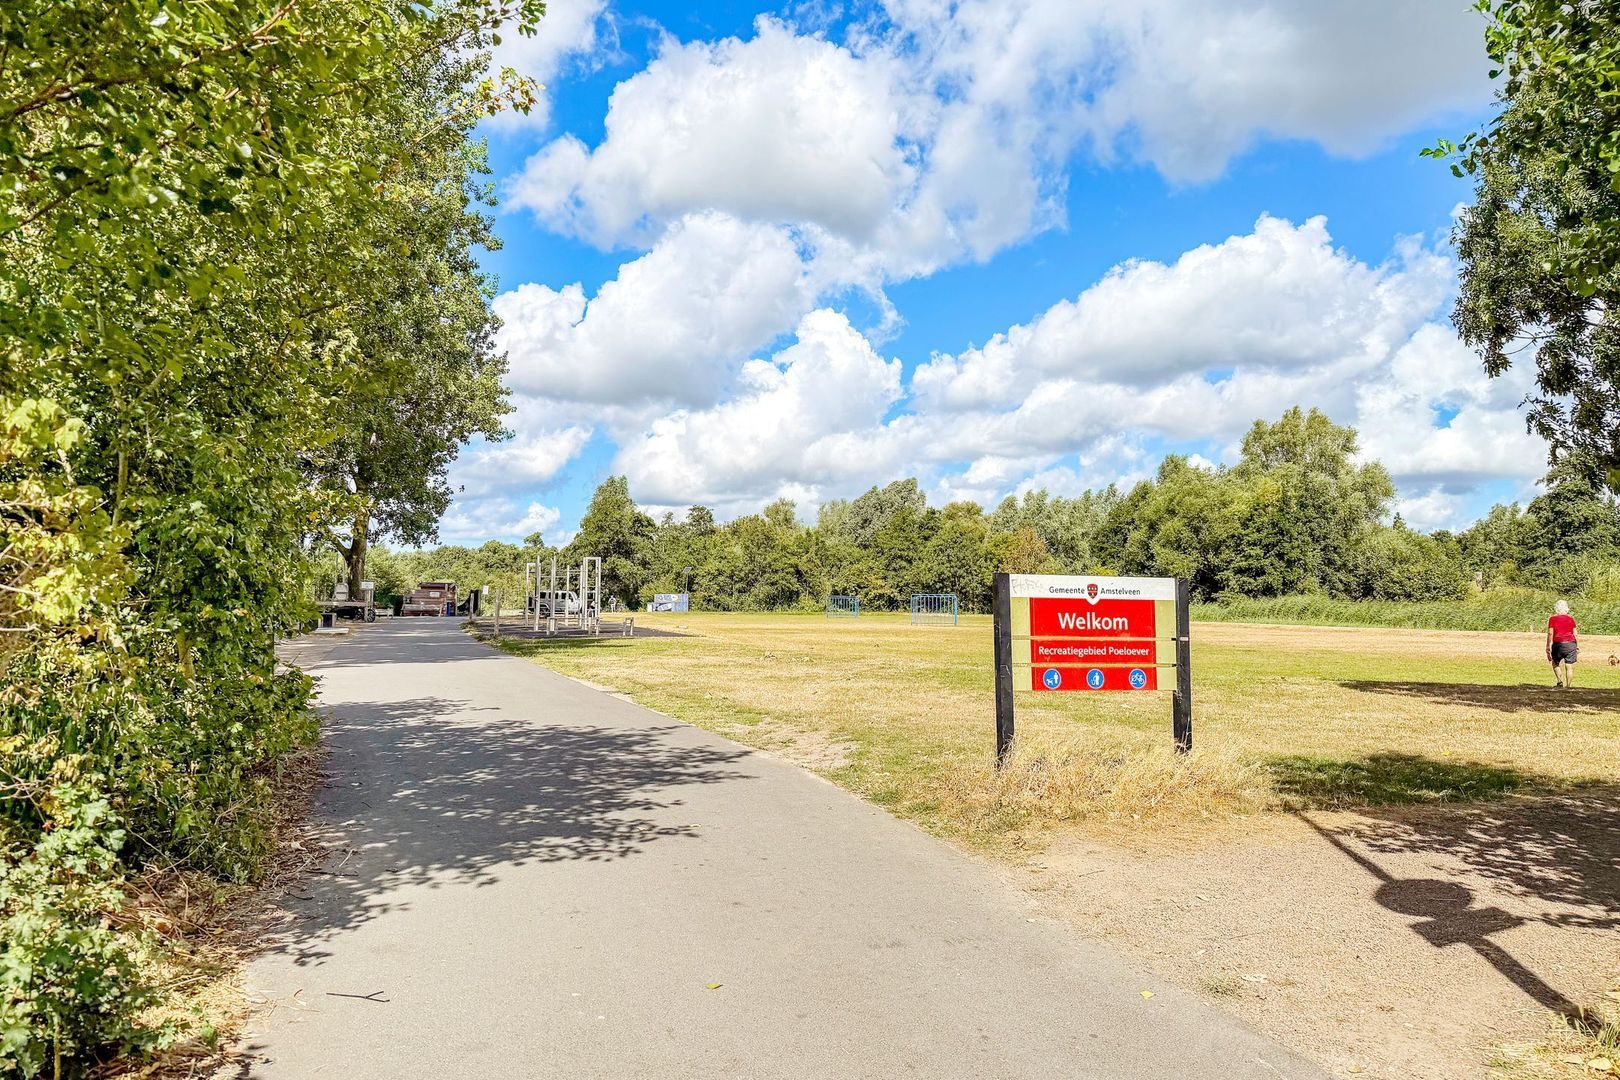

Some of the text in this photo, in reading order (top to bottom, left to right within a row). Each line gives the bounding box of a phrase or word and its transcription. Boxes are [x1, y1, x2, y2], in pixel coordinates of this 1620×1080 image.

[1049, 586, 1085, 594] Gemeente
[1100, 587, 1141, 595] Amstelveen
[1057, 612, 1129, 630] Welkom
[1038, 646, 1150, 658] Recreatiegebied Poeloever
